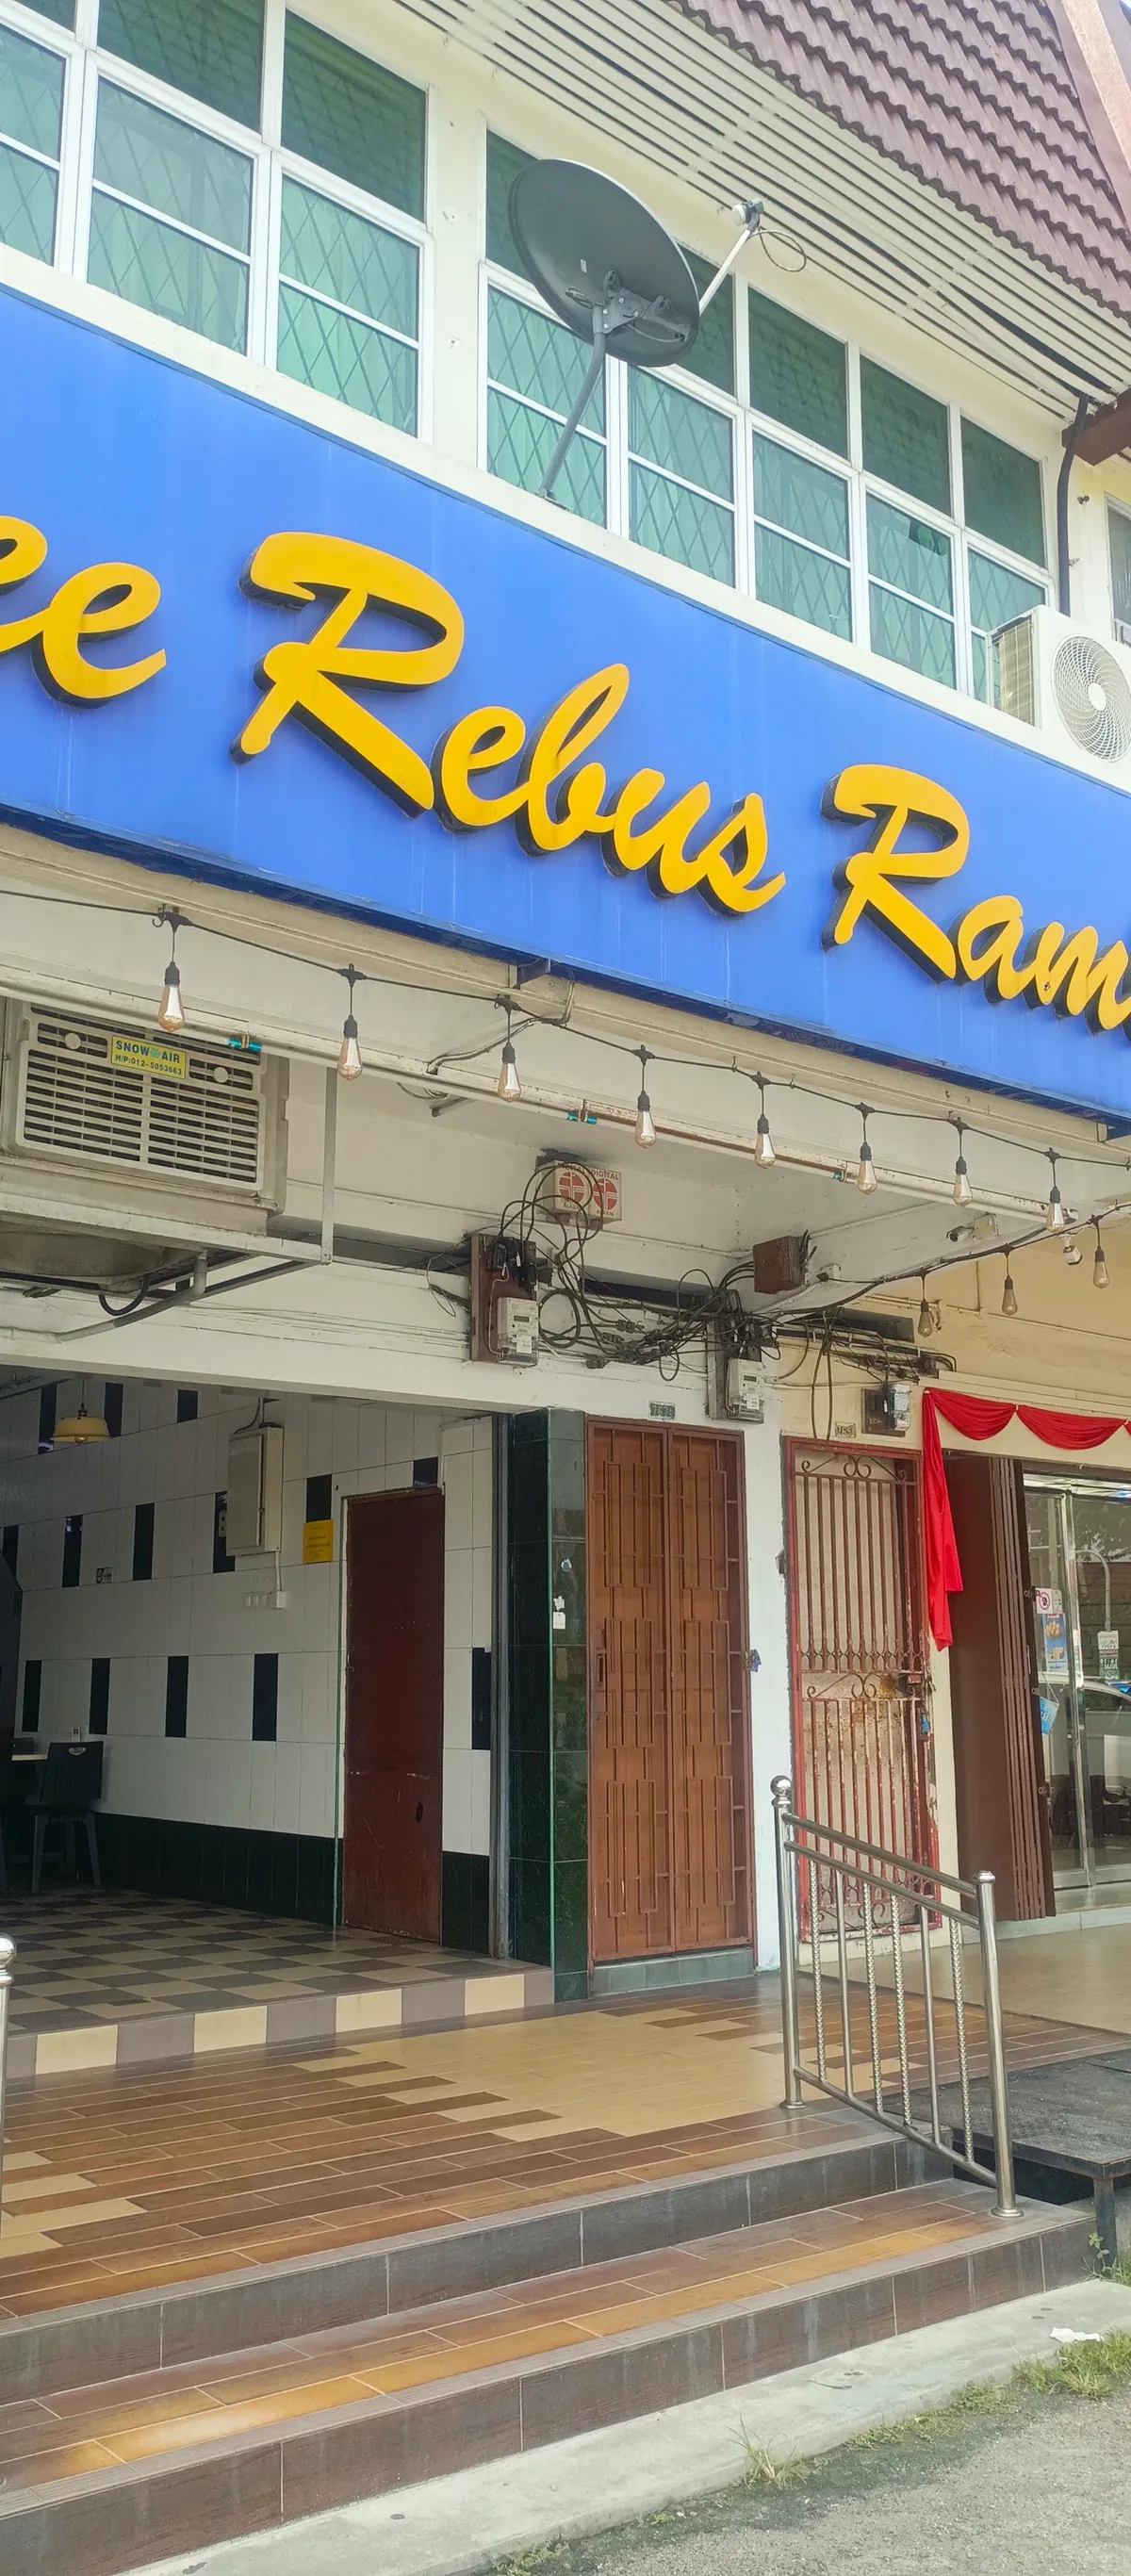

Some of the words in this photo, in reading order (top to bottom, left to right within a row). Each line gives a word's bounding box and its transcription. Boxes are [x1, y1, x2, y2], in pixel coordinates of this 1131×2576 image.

[234, 531, 786, 914] Rebus
[115, 1040, 150, 1057] SNOW
[161, 1051, 181, 1064] AIR
[590, 1169, 619, 1180] DIGITAL
